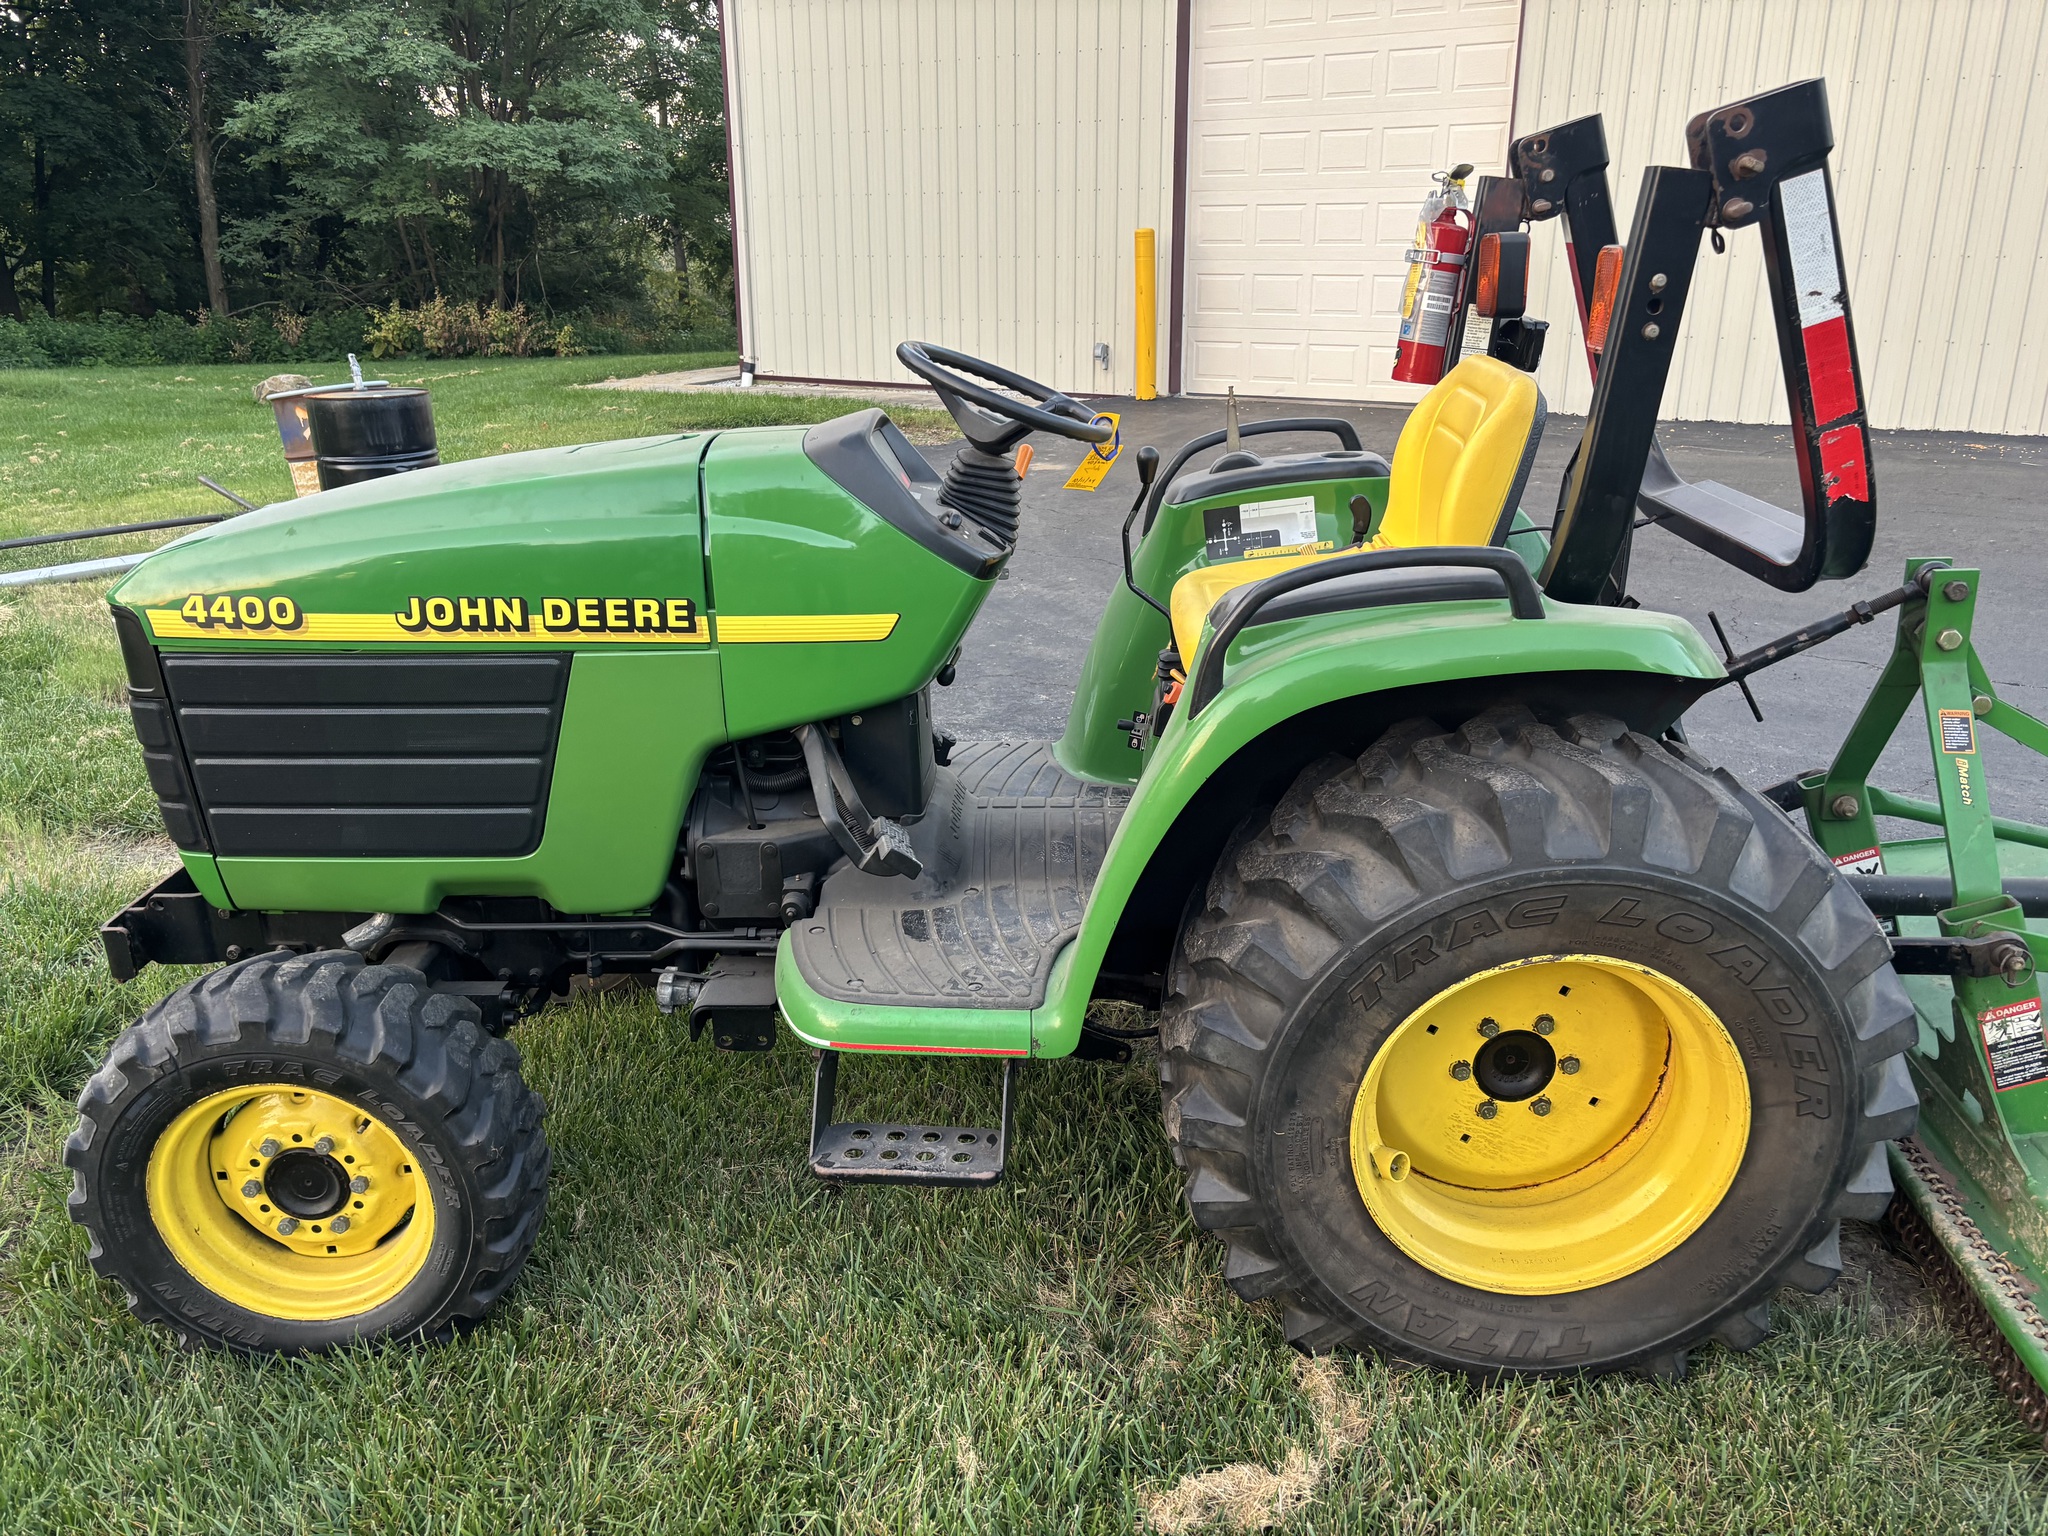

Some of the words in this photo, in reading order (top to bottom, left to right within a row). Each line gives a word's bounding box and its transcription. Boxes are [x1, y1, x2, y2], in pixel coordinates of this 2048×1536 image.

[180, 594, 303, 632] 4400
[395, 596, 529, 633] JOHN
[543, 597, 697, 634] DEERE
[1842, 849, 1876, 863] DANGER
[1348, 894, 1569, 1012] TRAC
[1597, 896, 1834, 1120] LOADER
[1995, 1001, 2037, 1017] DANGER
[222, 1058, 344, 1086] TRAC
[356, 1088, 462, 1210] LOADER
[151, 1281, 266, 1347] TITAN
[1348, 1280, 1592, 1358] TITAN
[1499, 1303, 1533, 1313] MADE
